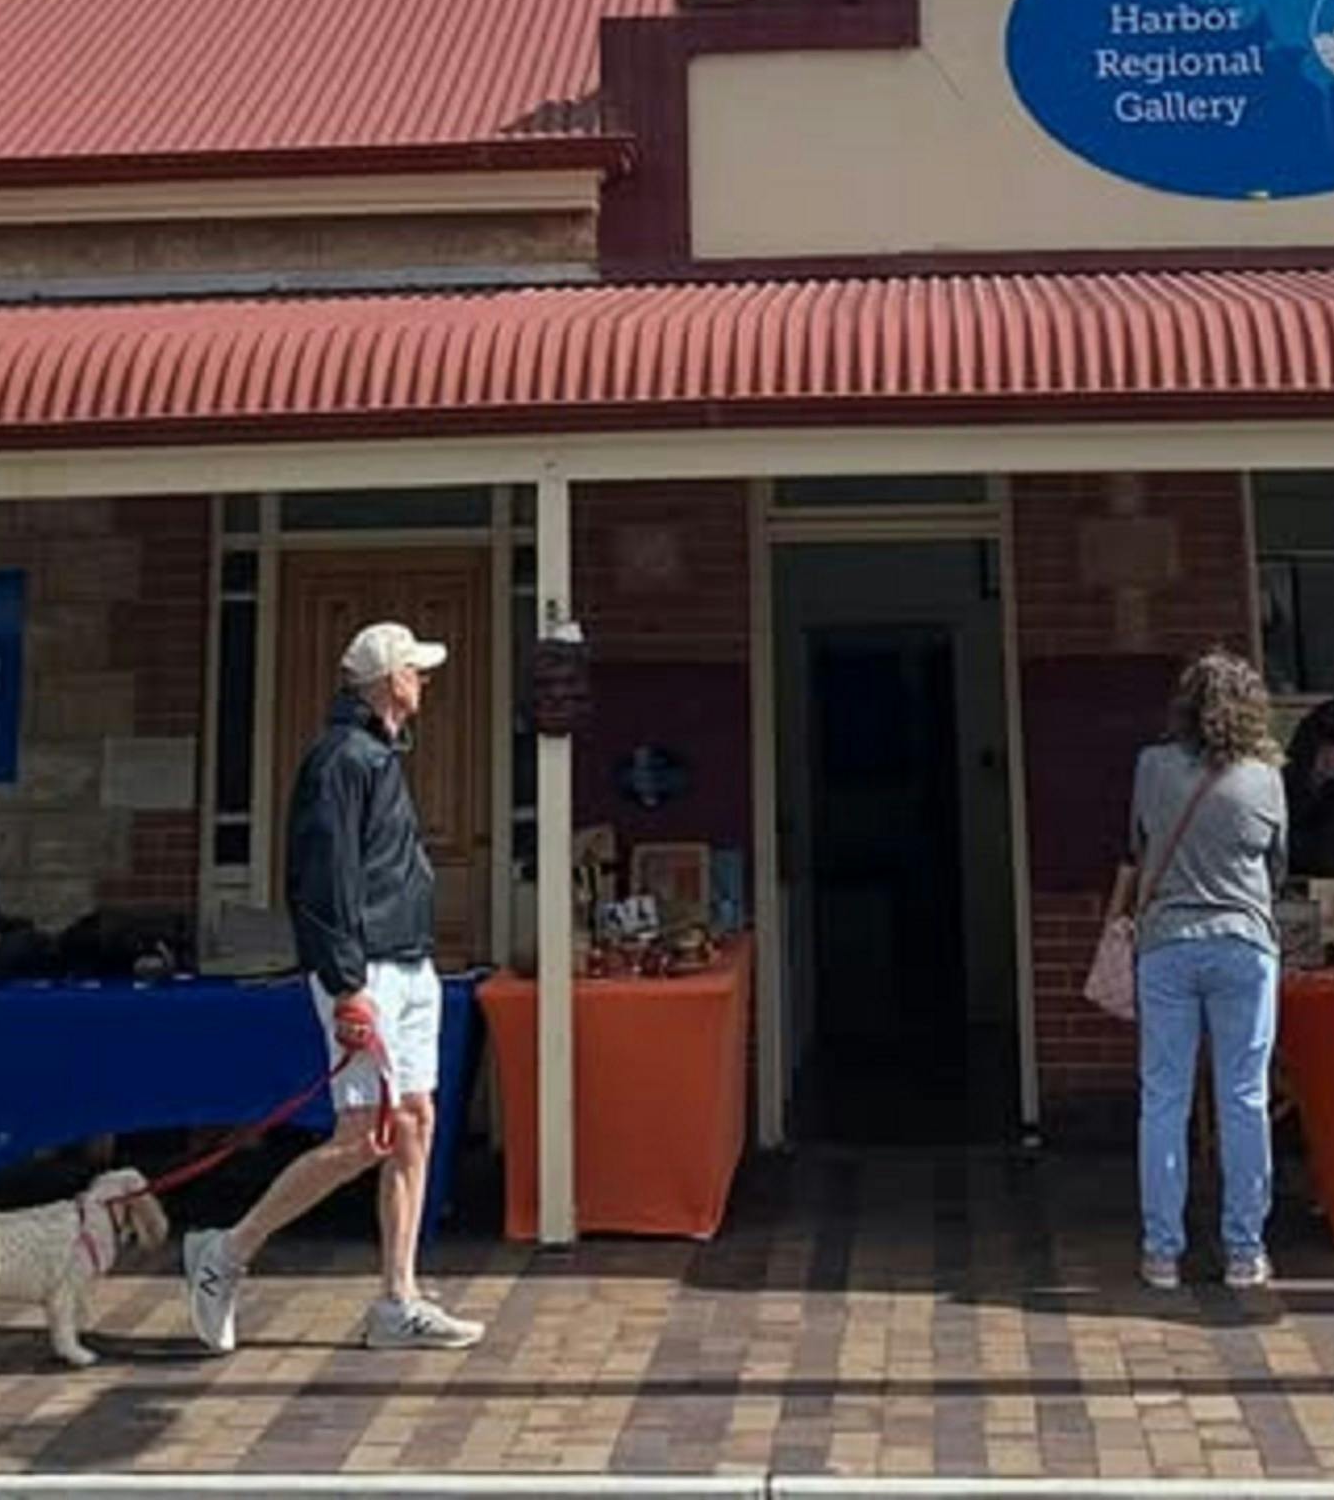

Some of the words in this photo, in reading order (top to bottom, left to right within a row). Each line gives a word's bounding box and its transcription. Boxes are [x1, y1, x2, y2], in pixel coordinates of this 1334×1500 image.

[1110, 4, 1242, 35] Harbor
[1096, 46, 1264, 84] Regional
[1114, 92, 1247, 126] Gallery
